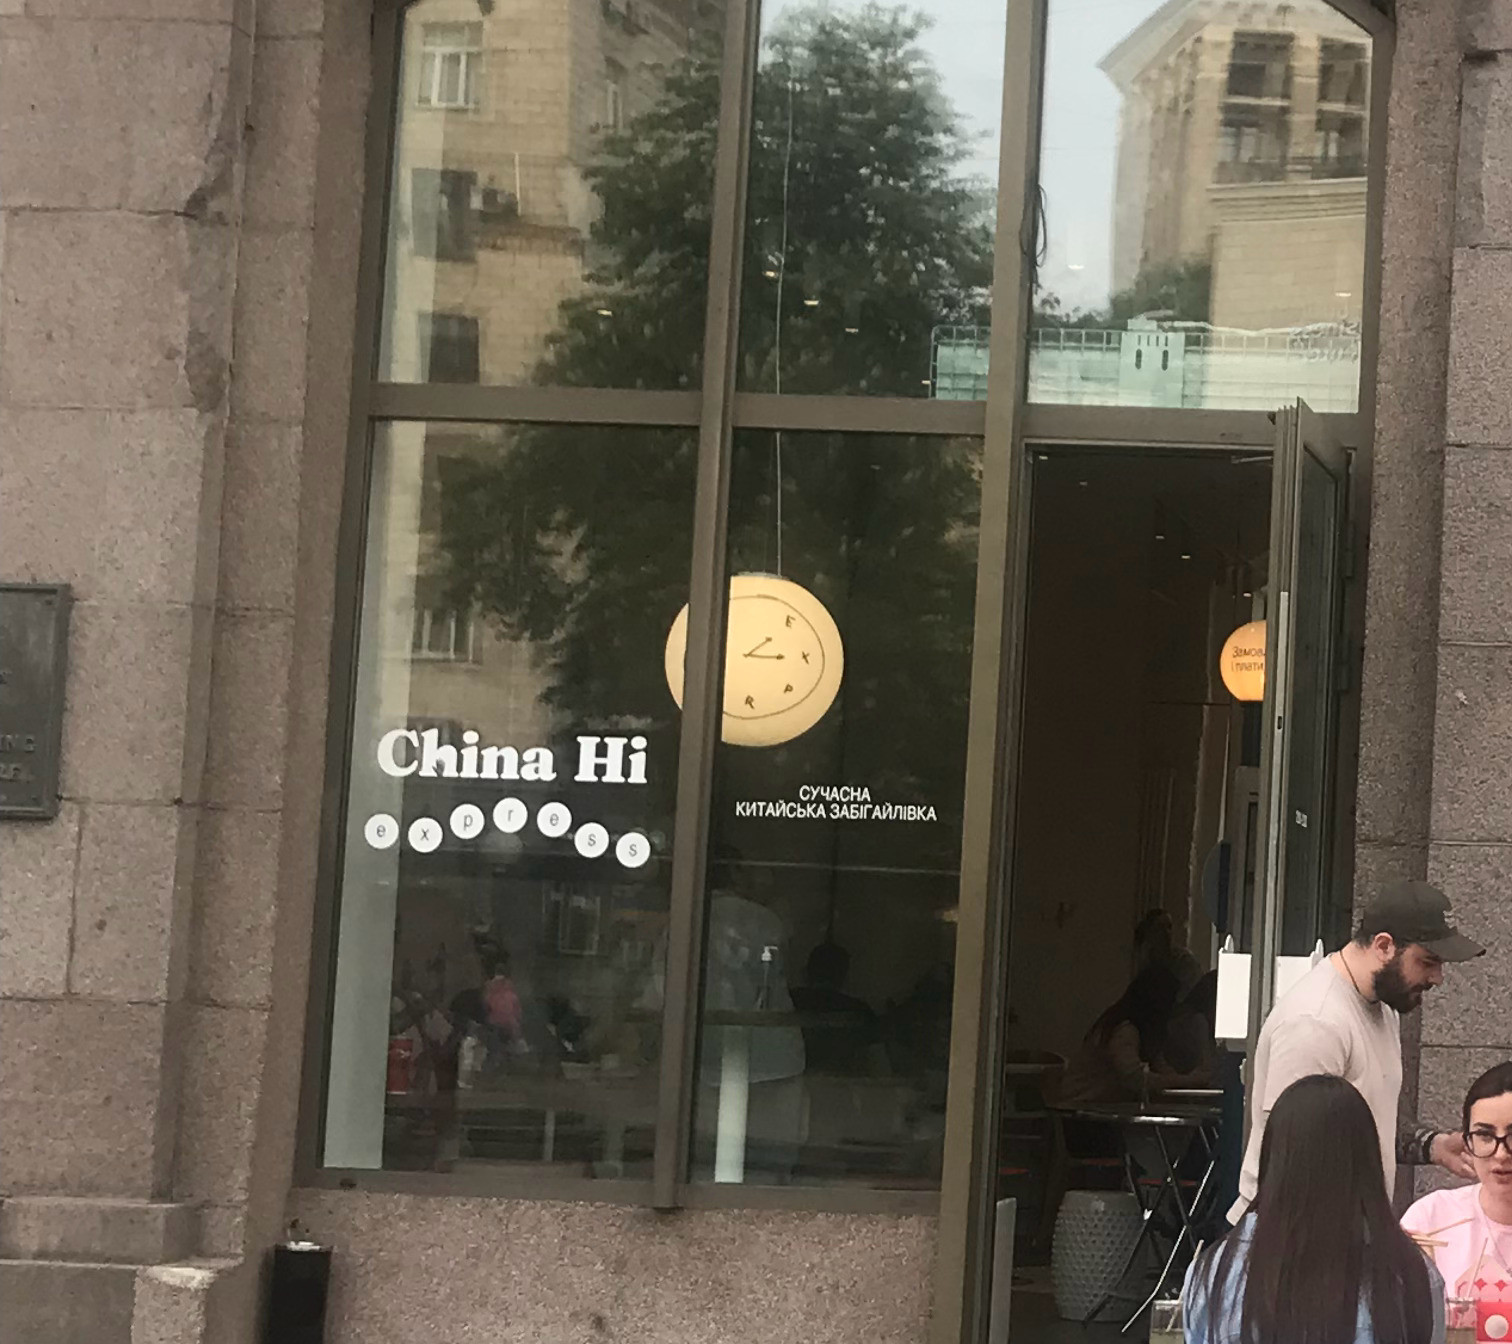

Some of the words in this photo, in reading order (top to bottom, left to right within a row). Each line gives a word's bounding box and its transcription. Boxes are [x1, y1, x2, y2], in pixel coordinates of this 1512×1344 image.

[377, 728, 557, 782] China
[574, 735, 648, 784] Hi
[735, 800, 826, 819] КИТАЙСЬКА
[829, 801, 938, 821] ЗАБІГАЙЛІВКА
[799, 784, 871, 802] СУЧАСНА
[372, 802, 643, 862] express
